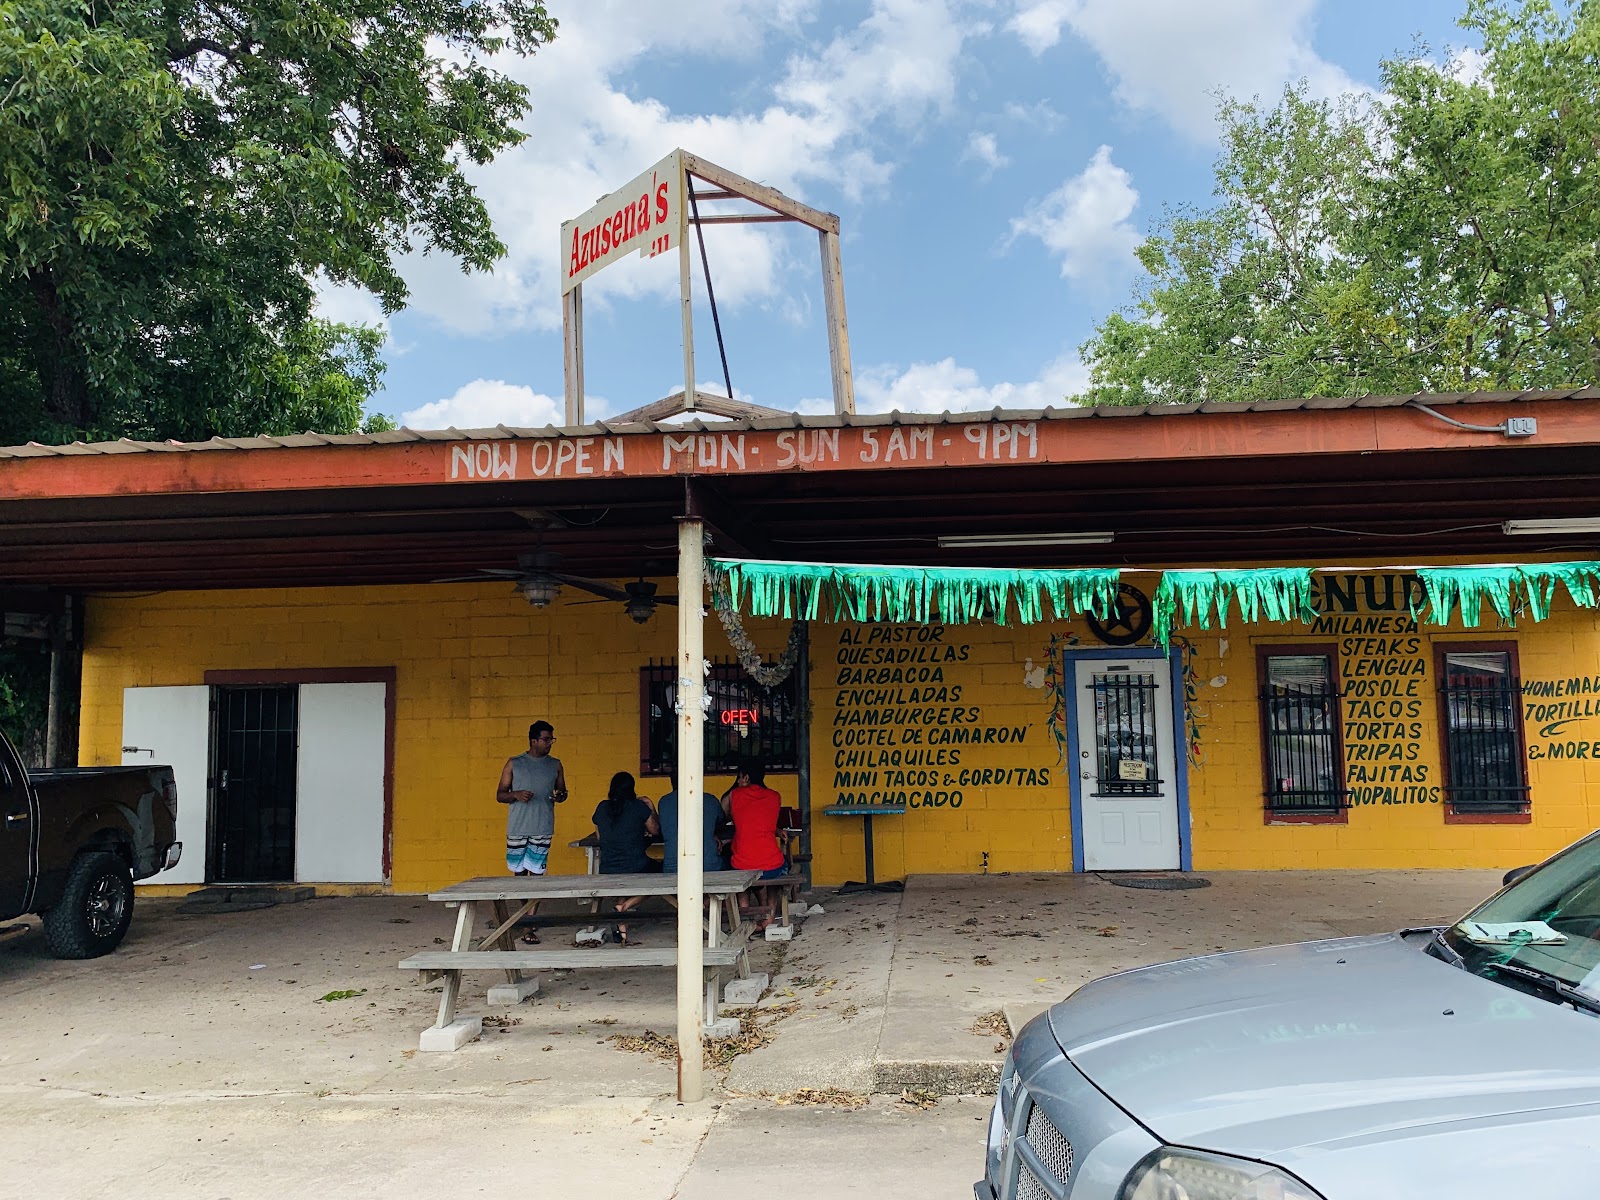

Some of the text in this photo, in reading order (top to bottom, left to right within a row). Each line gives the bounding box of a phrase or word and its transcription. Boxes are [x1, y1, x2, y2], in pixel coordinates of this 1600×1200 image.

[569, 171, 668, 278] Azusena's
[451, 442, 517, 479] NOW
[531, 437, 625, 477] OPEN
[776, 428, 840, 466] SUN
[963, 422, 1038, 460] 9PM
[1310, 616, 1419, 634] MILANESA
[838, 626, 945, 645] AL PASTOR
[837, 645, 970, 665] QUESADILLAS
[1340, 637, 1421, 657] STEAKS
[836, 667, 944, 686] BARBACOA
[1342, 658, 1426, 678] LENGUA
[835, 685, 963, 706] ENCHILADAS
[721, 709, 757, 724] OPEN
[833, 706, 980, 726] HAMBURGERS
[1346, 700, 1422, 719] TACOS
[832, 728, 897, 747] COCTEL
[901, 728, 923, 745] DE
[1344, 722, 1422, 740] TORTAS
[834, 749, 961, 768] CHILAQUILES
[1345, 743, 1420, 761] TRIPAS
[1528, 741, 1600, 760] & MORE
[833, 767, 1050, 788] MINI TACOS & GORDITAS
[1347, 764, 1429, 783] FAJITAS
[836, 790, 963, 808] MACHACADO
[1349, 786, 1440, 806] NOPALITOS
